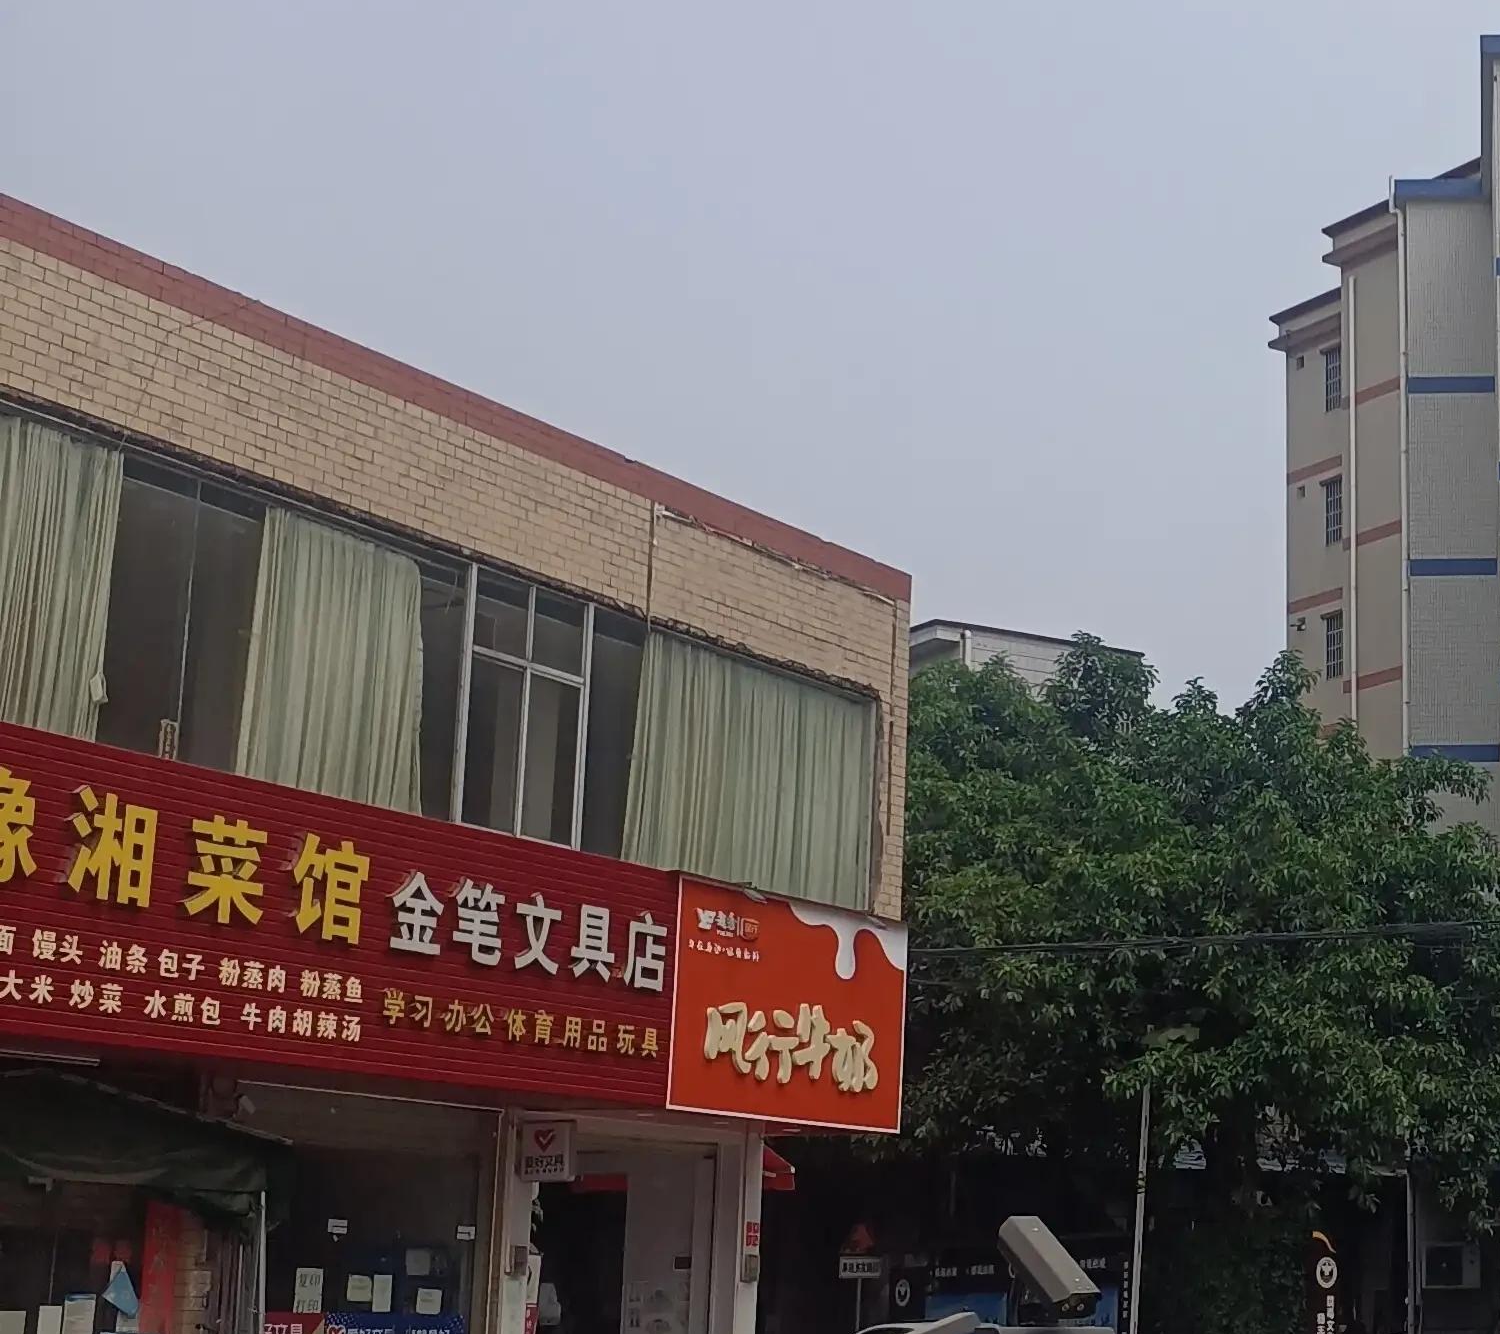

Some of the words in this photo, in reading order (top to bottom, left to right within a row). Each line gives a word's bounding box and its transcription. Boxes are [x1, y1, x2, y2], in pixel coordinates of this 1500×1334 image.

[32, 928, 83, 965] 馒头
[98, 939, 148, 974] 油条
[158, 948, 205, 981] 包子
[218, 957, 286, 993] 粉蒸肉
[300, 970, 363, 1004] 粉蒸鱼
[388, 870, 668, 992] 金笔文具店
[69, 979, 123, 1014] 炒菜
[144, 989, 221, 1026] 水煎包
[240, 1002, 362, 1043] 牛肉胡辣汤
[383, 987, 433, 1028] 学习
[442, 999, 495, 1035] 办公
[616, 1024, 659, 1058] 玩具
[703, 1001, 878, 1094] 风行牛奶
